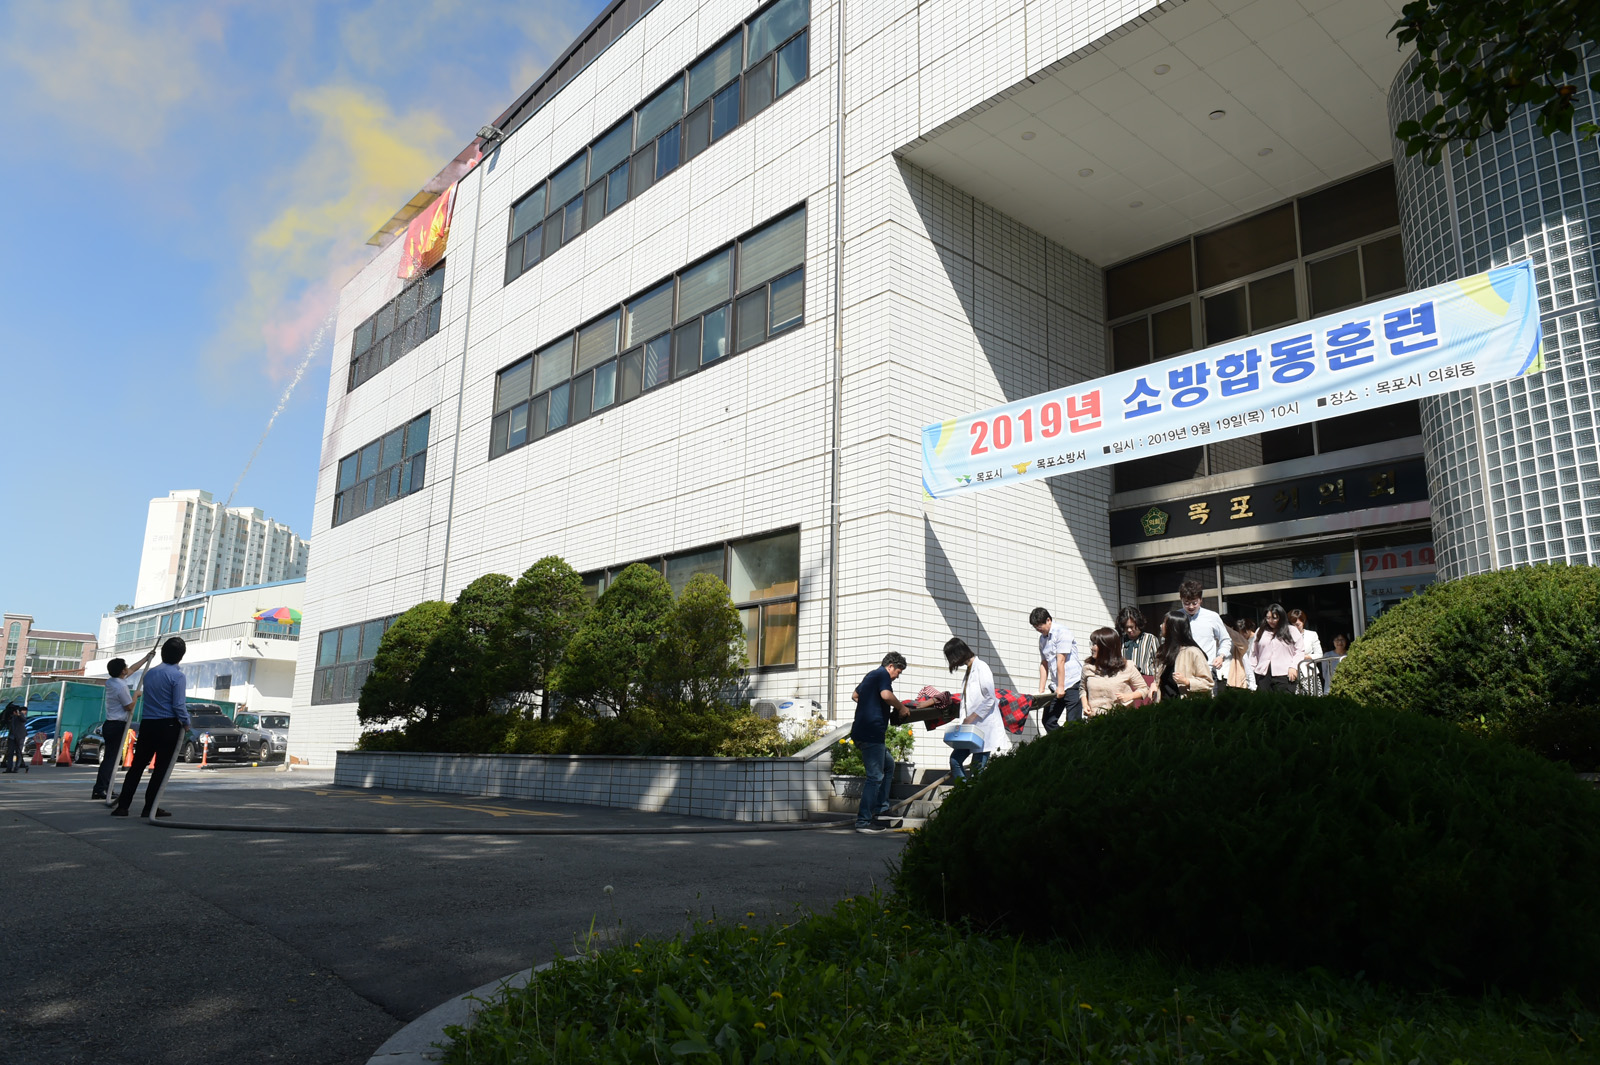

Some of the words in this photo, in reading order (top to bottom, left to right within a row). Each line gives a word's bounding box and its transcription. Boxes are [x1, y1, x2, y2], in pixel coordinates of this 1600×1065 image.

[970, 389, 1102, 456] 2019년
[1123, 301, 1439, 420] 소방합동훈련
[1329, 389, 1359, 406] 장소
[1376, 373, 1422, 394] 목포시
[1428, 361, 1476, 383] 의회동
[1112, 438, 1135, 454] 일시
[1147, 427, 1187, 446] 2019년
[1190, 421, 1211, 436] 9월
[1215, 408, 1265, 430] 19일(목)
[1270, 401, 1300, 419] 10시
[976, 468, 1003, 483] 목포시
[1036, 449, 1087, 470] 목포소방서
